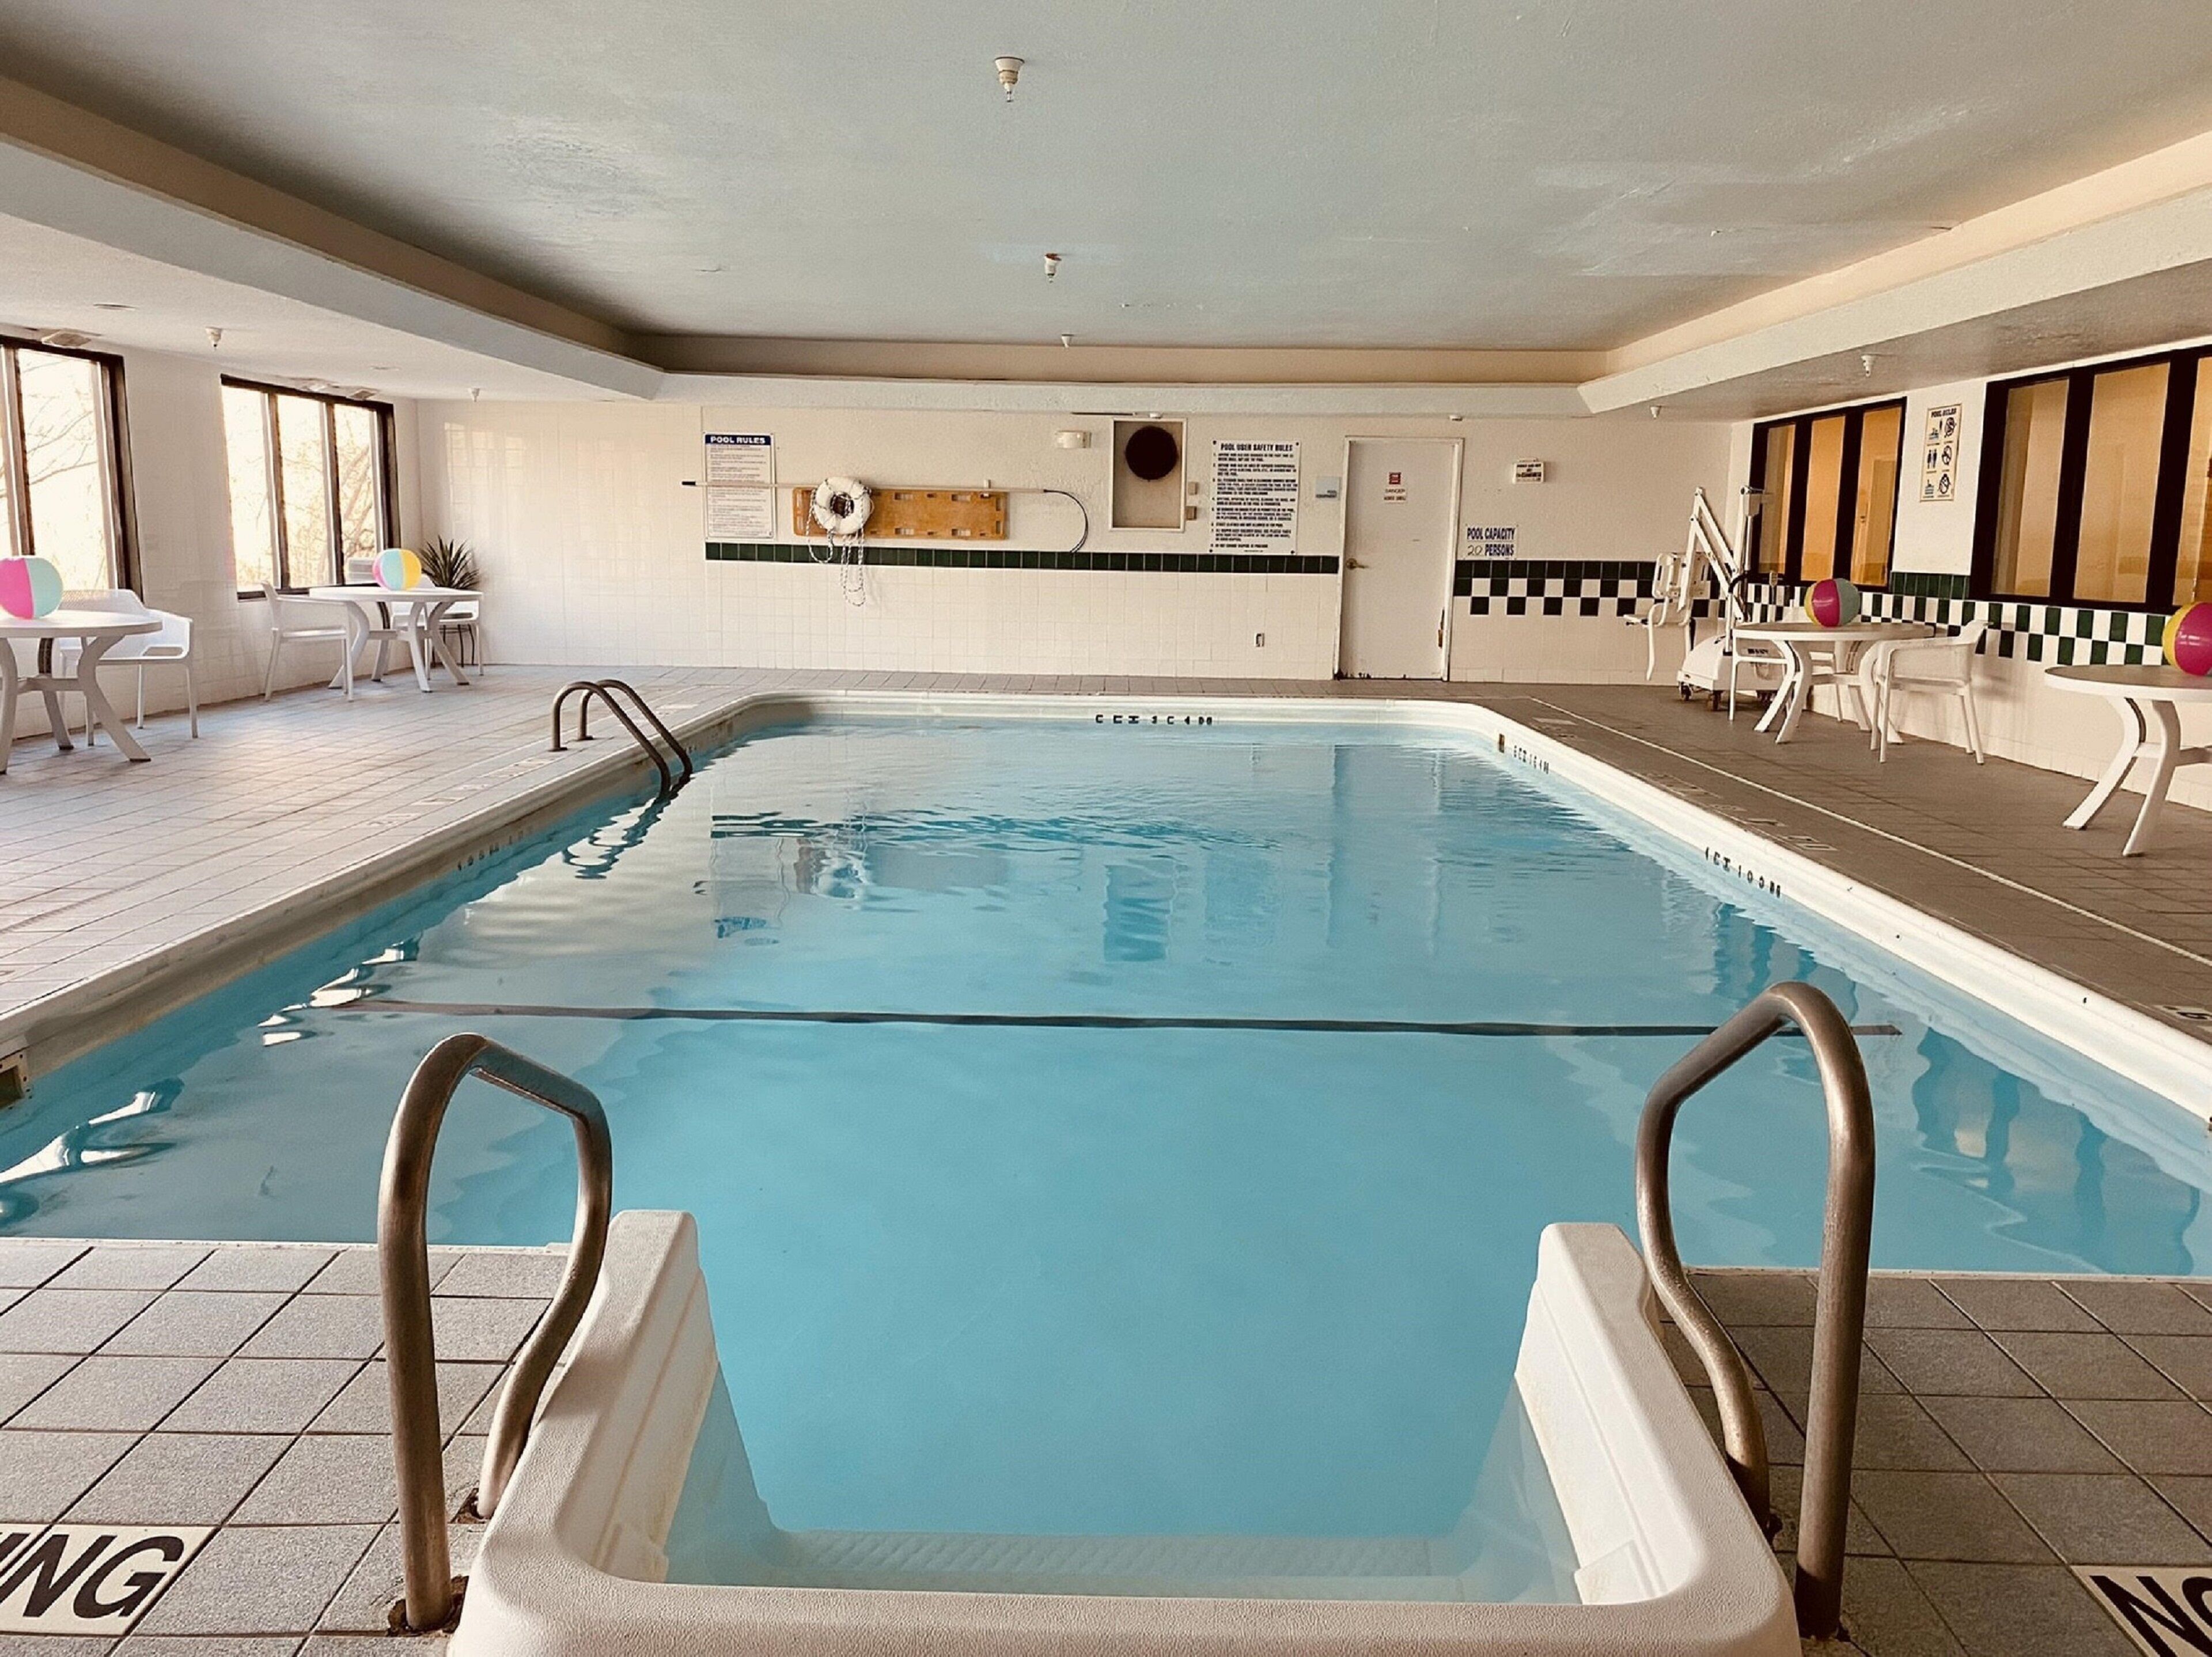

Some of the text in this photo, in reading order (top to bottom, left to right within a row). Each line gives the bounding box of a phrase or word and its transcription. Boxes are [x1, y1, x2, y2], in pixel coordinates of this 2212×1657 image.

[1221, 443, 1235, 451] POOL
[1467, 528, 1515, 540] POOL CAPACITY
[1467, 544, 1514, 557] 20 PERSONS
